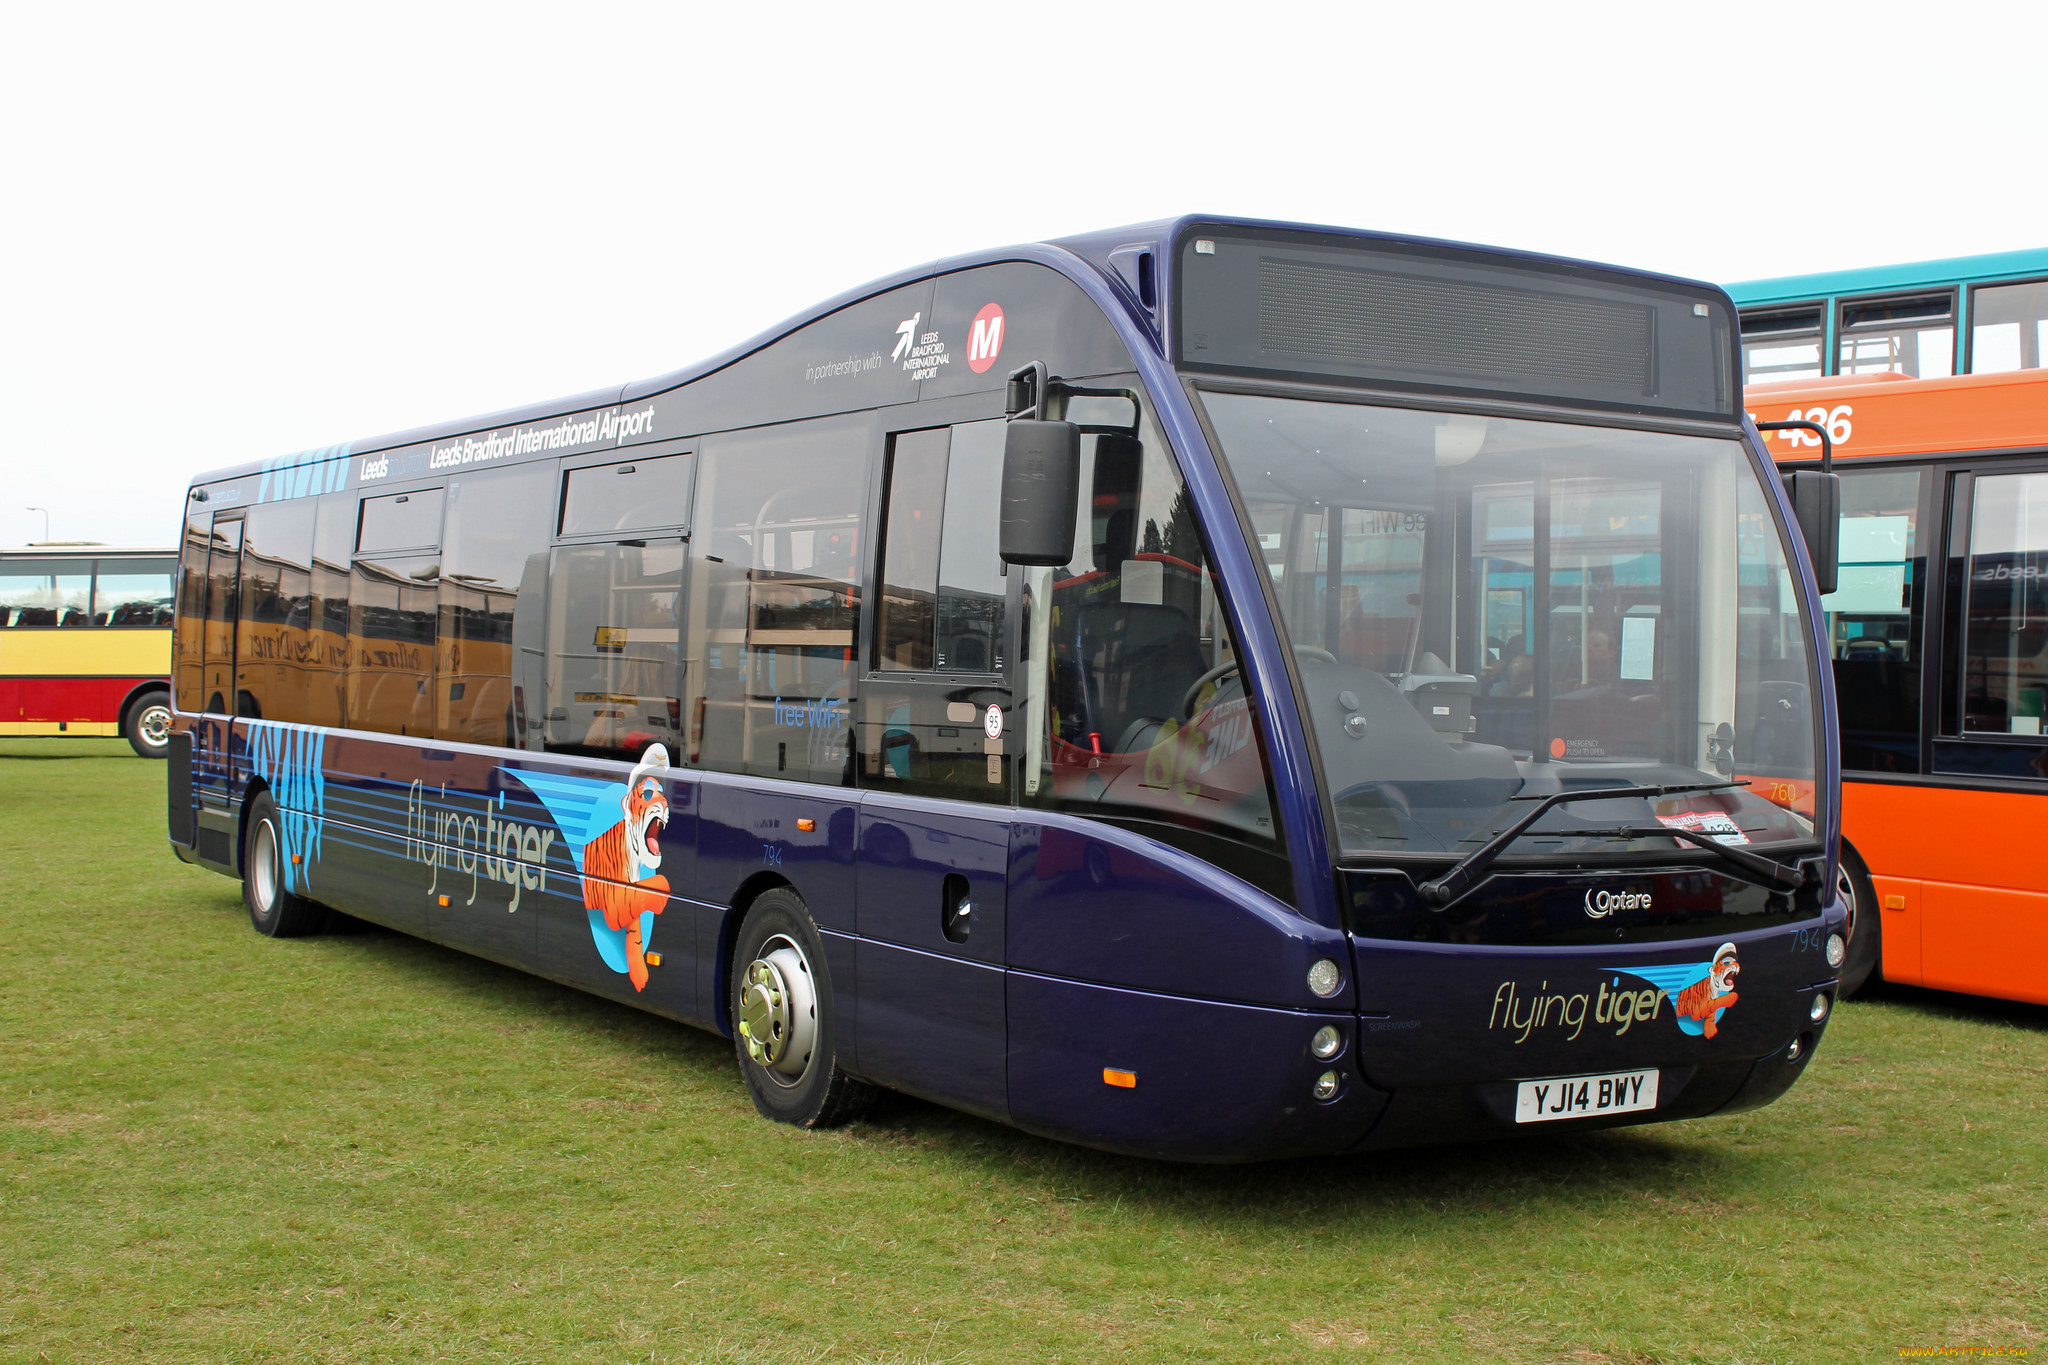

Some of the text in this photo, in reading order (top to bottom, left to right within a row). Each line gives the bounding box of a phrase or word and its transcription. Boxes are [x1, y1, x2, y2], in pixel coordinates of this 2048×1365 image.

[911, 342, 945, 357] BRADFORD
[920, 331, 939, 345] LEEDS
[969, 316, 1002, 361] M
[805, 350, 882, 385] in partnership with
[902, 352, 950, 371] INTERNATIONAL
[911, 367, 938, 381] AIRPORT
[1778, 404, 1854, 448] 436
[360, 454, 389, 481] Leeds
[429, 439, 463, 470] Leeds
[462, 428, 517, 465] Bradford
[515, 411, 601, 455] International
[599, 404, 655, 446] Airport
[774, 696, 841, 729] free WiFi
[989, 715, 999, 729] 95
[1566, 739, 1599, 748] EMERGENCY
[1566, 748, 1605, 756] PUSH TO OPEN
[1769, 782, 1796, 802] 760
[406, 778, 555, 913] flying tiger
[1596, 890, 1652, 916] Optare
[1489, 976, 1671, 1044] flying tiger
[1534, 1075, 1645, 1115] YJ14 BWY
